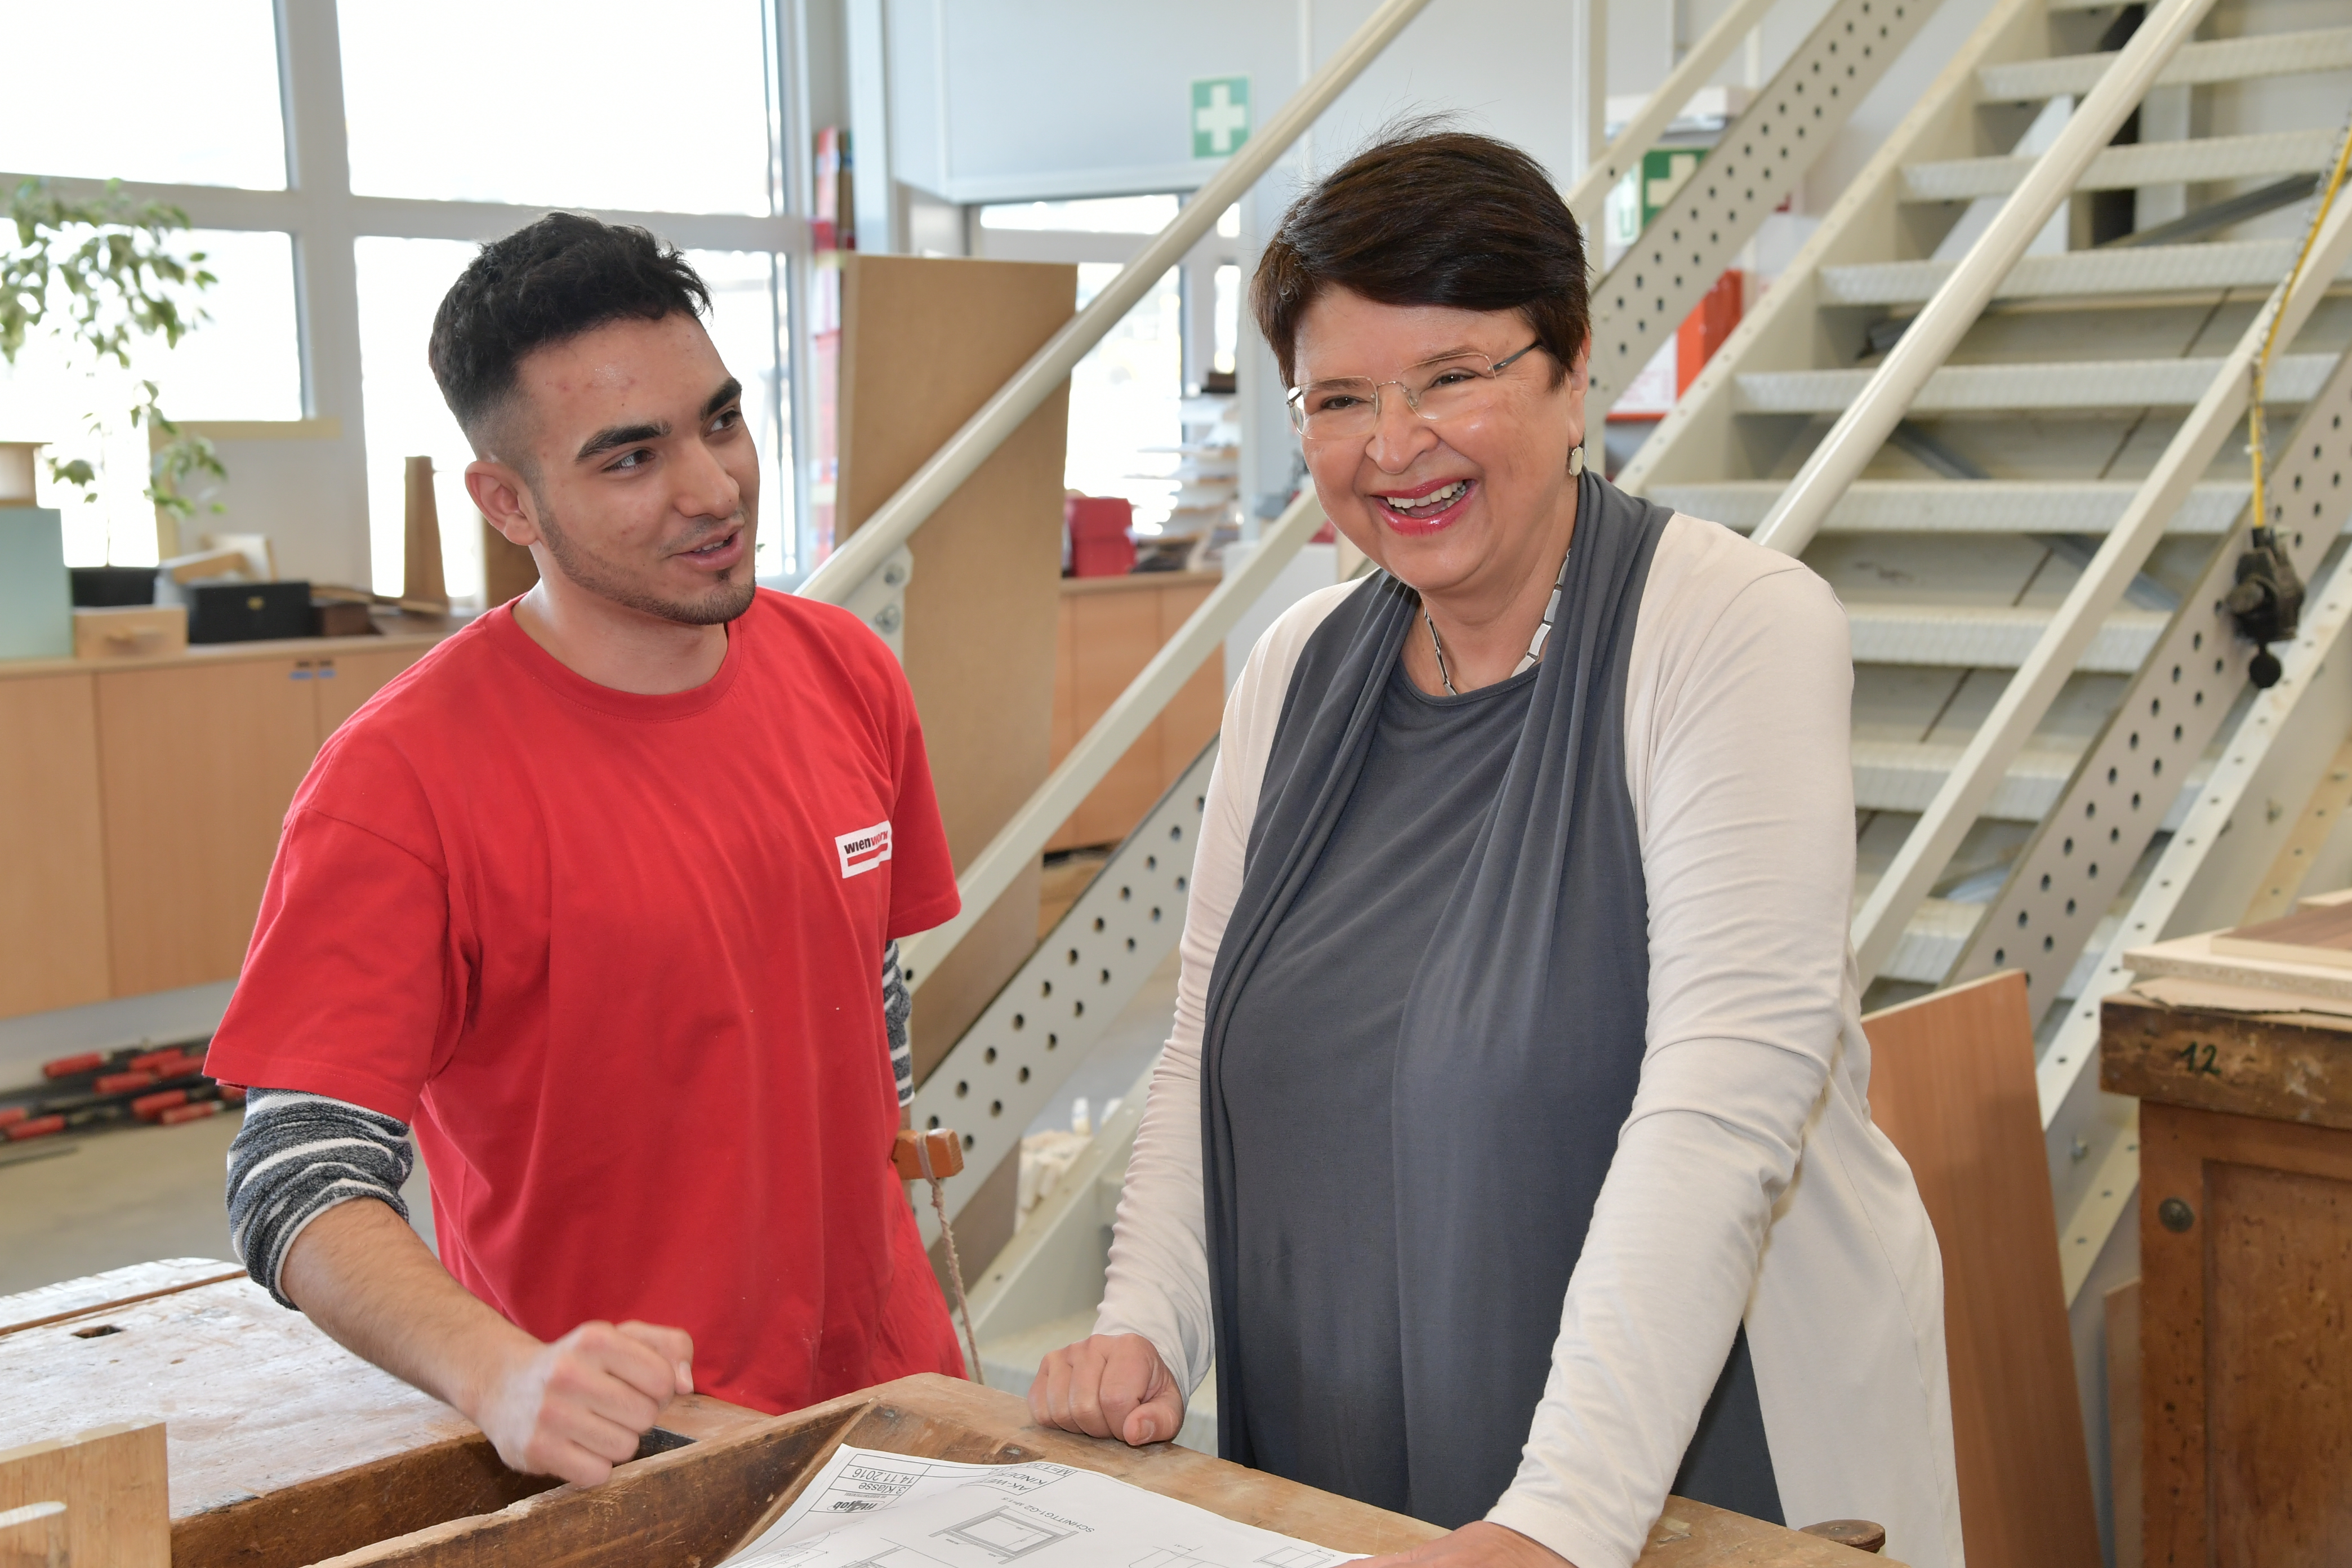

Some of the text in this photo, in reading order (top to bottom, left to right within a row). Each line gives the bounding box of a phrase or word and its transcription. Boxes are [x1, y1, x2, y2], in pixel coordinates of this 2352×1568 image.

[2181, 1041, 2221, 1075] 12
[852, 1468, 915, 1485] 14.11.2016
[858, 1482, 906, 1494] 3.Klasse
[832, 1500, 879, 1513] fit4job
